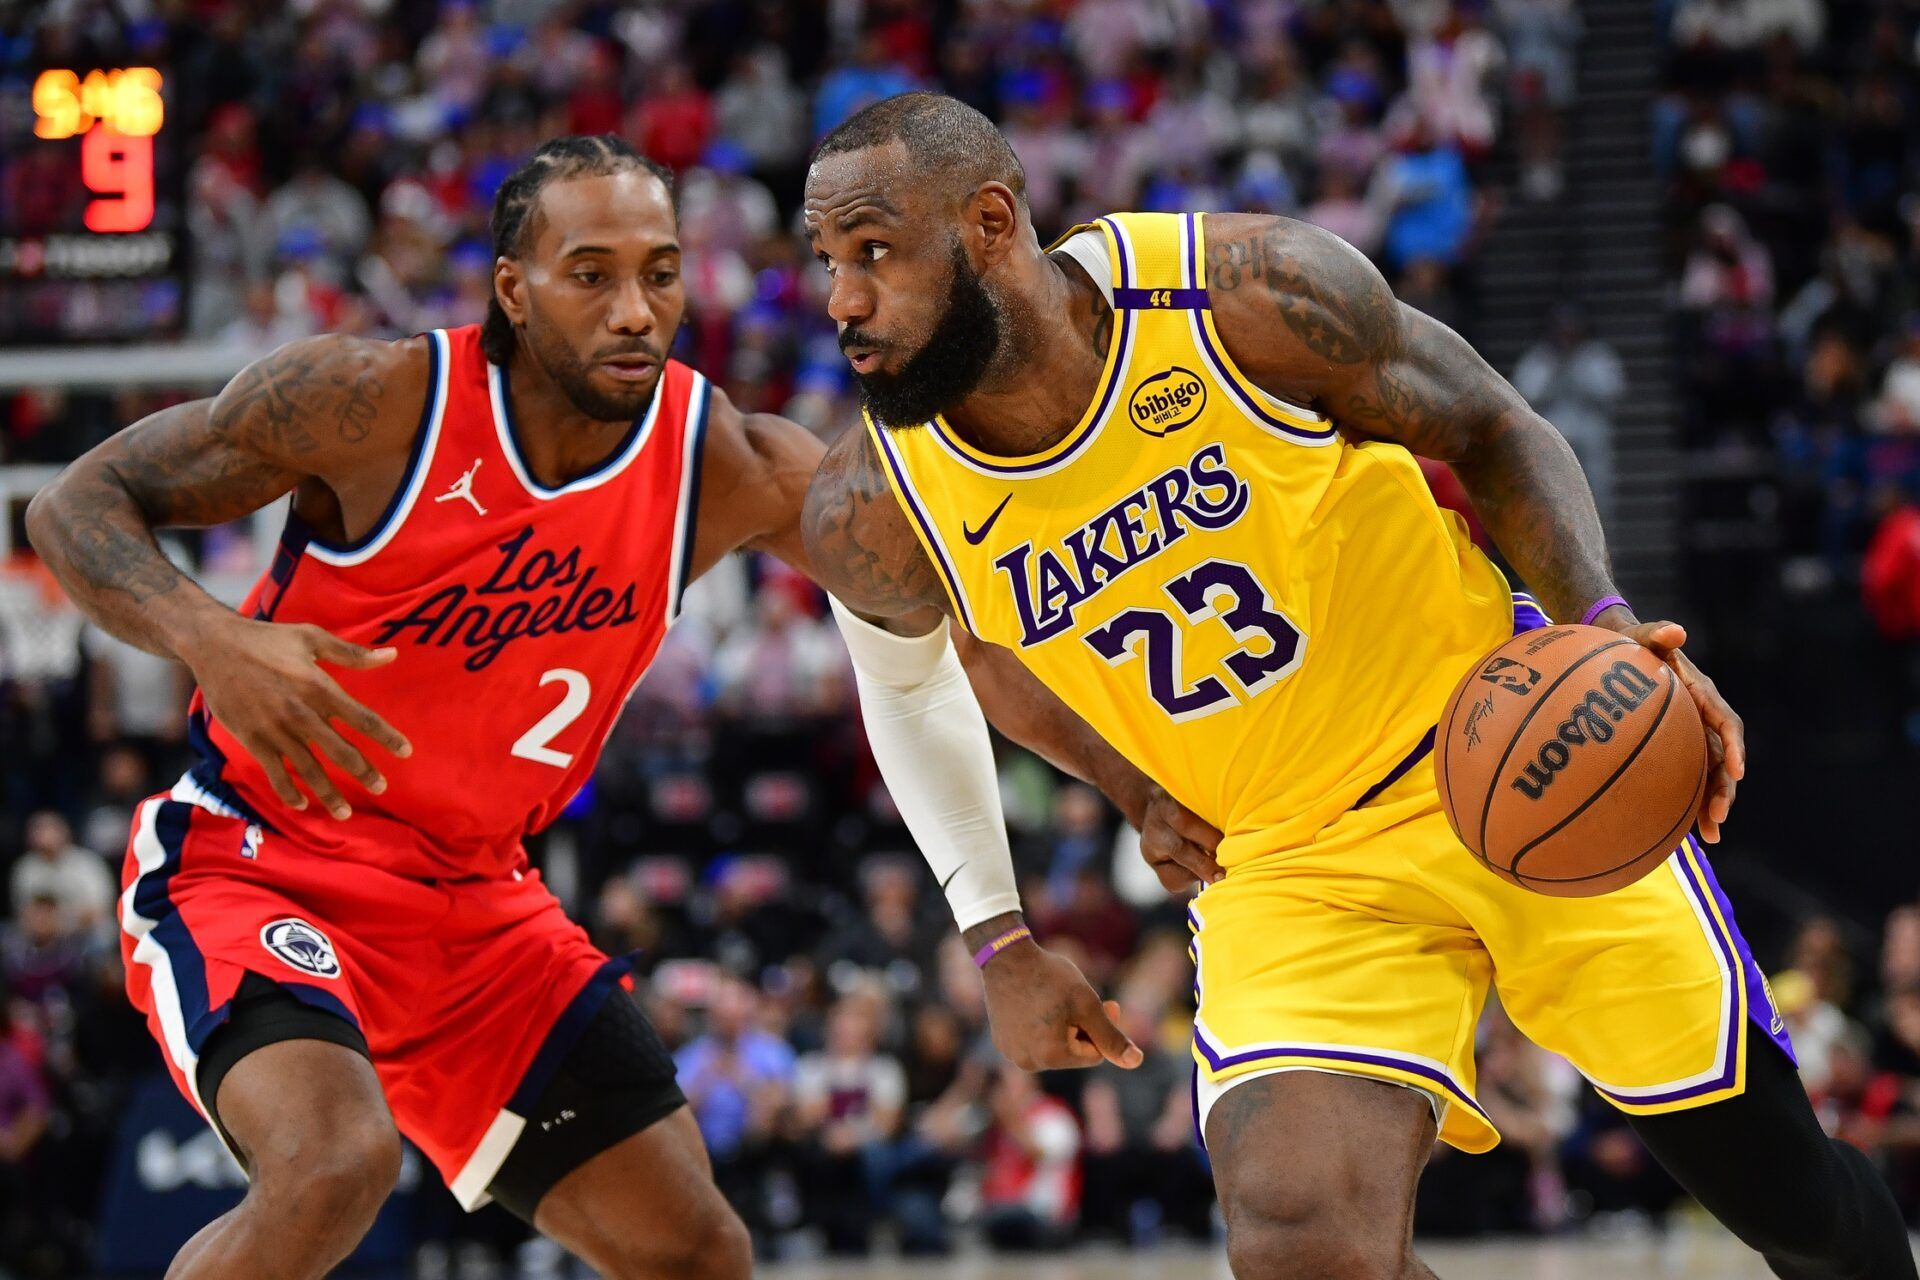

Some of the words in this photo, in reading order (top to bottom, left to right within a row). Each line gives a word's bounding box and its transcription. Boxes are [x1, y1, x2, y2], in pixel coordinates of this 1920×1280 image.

[82, 121, 155, 232] 9
[1150, 290, 1171, 307] 44
[1134, 381, 1200, 420] bibigo
[1153, 406, 1181, 425] 비비고
[475, 525, 582, 595] Los
[992, 441, 1252, 648] LAKERS
[370, 567, 640, 672] Angeles
[1079, 557, 1310, 724] 23
[510, 667, 591, 769] 2
[1510, 661, 1659, 800] Wilson
